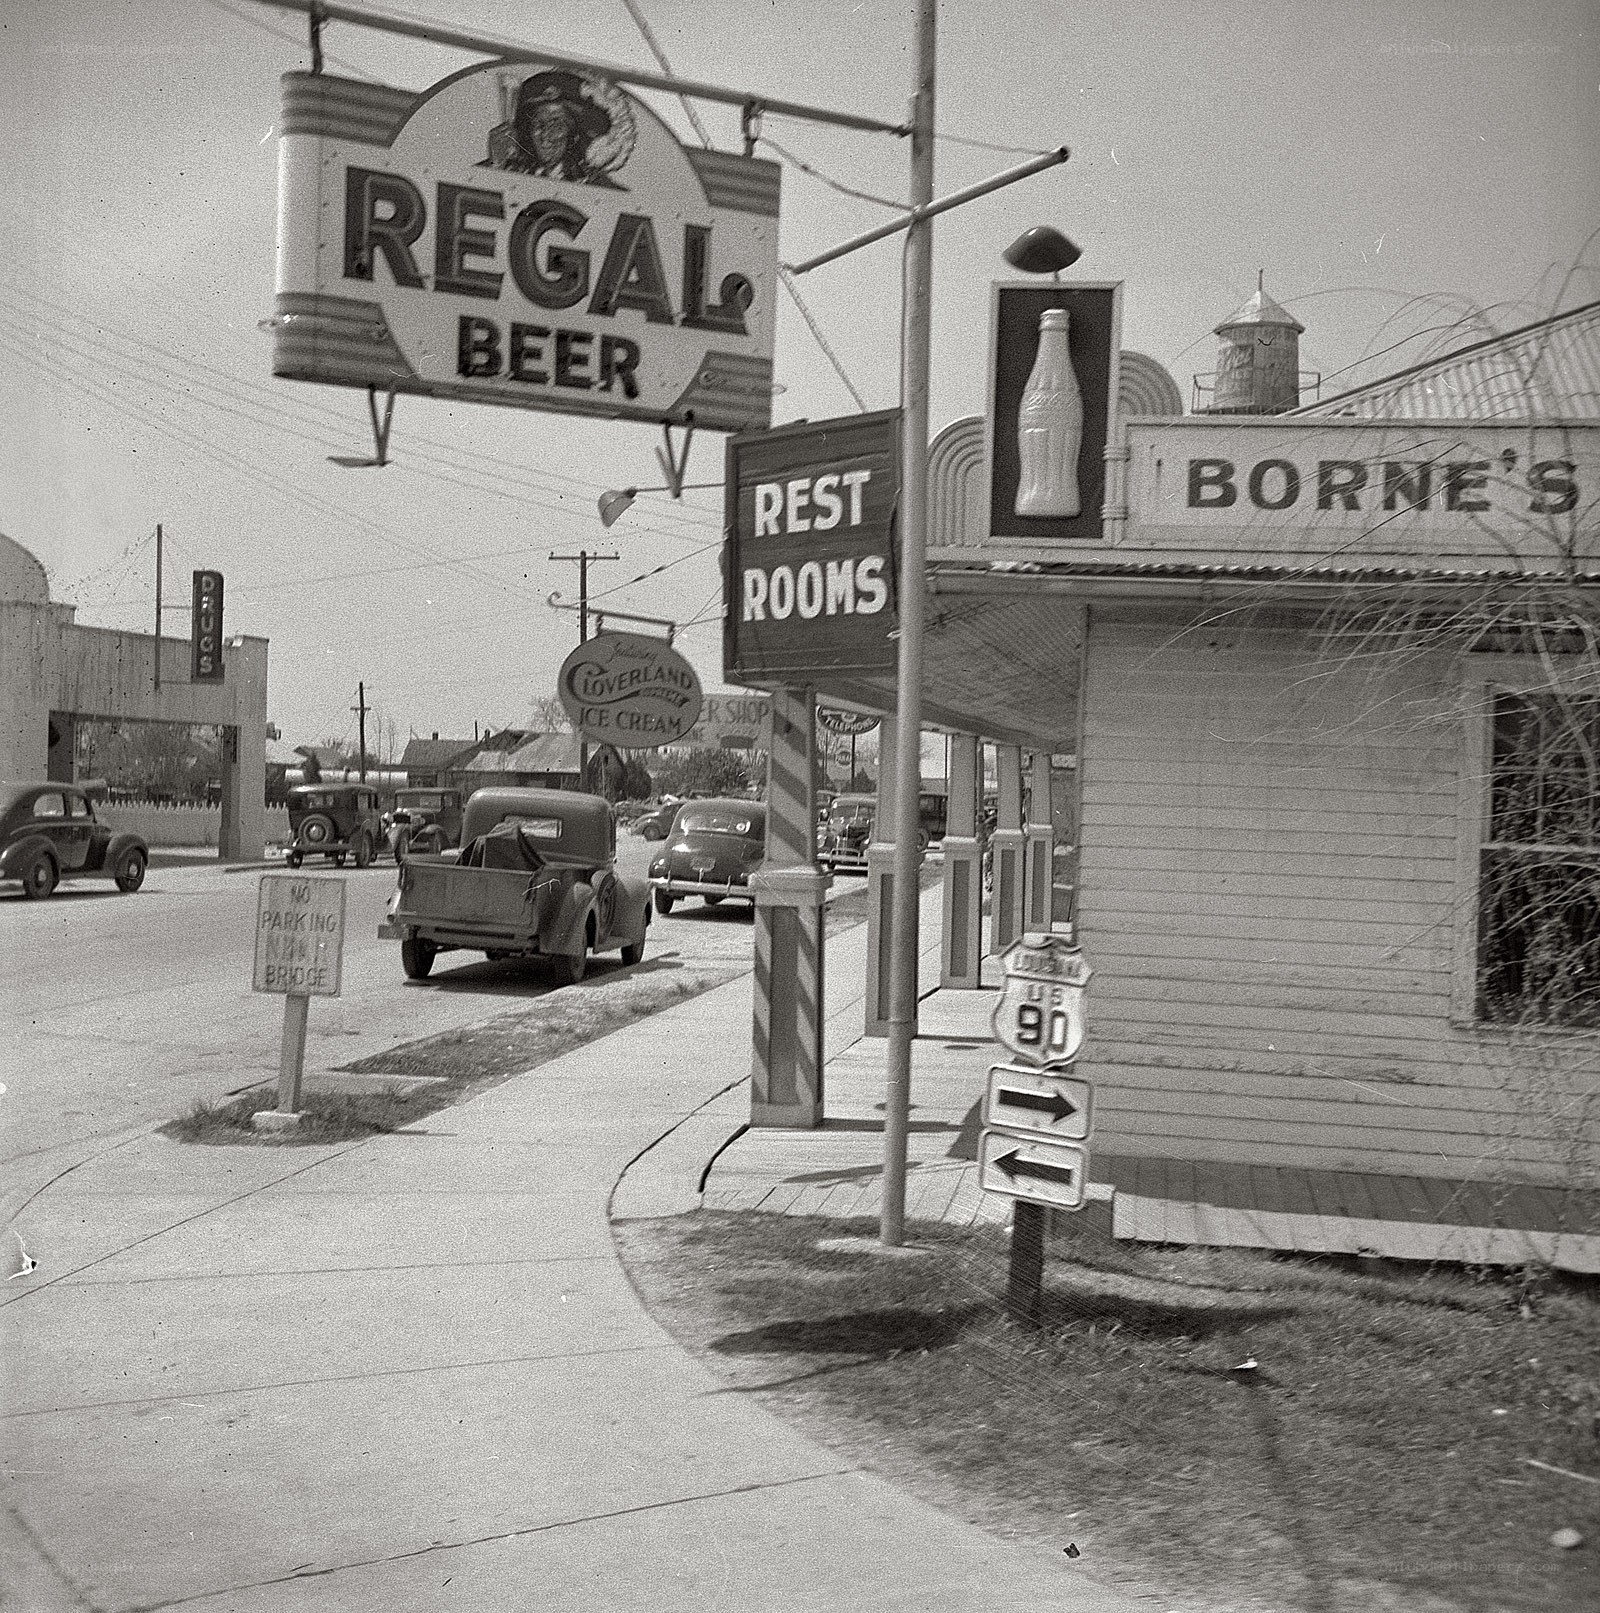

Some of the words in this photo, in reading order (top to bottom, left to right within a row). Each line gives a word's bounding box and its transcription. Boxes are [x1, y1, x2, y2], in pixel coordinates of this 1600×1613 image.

[343, 165, 754, 335] REGAL
[458, 315, 641, 399] BEER
[755, 469, 871, 537] REST
[1187, 448, 1580, 514] BORNE'S
[743, 554, 888, 622] ROOMS
[200, 575, 215, 673] DRUGS
[566, 661, 693, 704] CLOVERLAND
[579, 707, 611, 727] ICE
[616, 710, 682, 735] CREAM
[725, 698, 770, 725] SHOP
[290, 885, 310, 904] NO
[261, 910, 337, 933] PARKING
[264, 964, 328, 988] BRIDGE
[1016, 1003, 1069, 1054] 90
